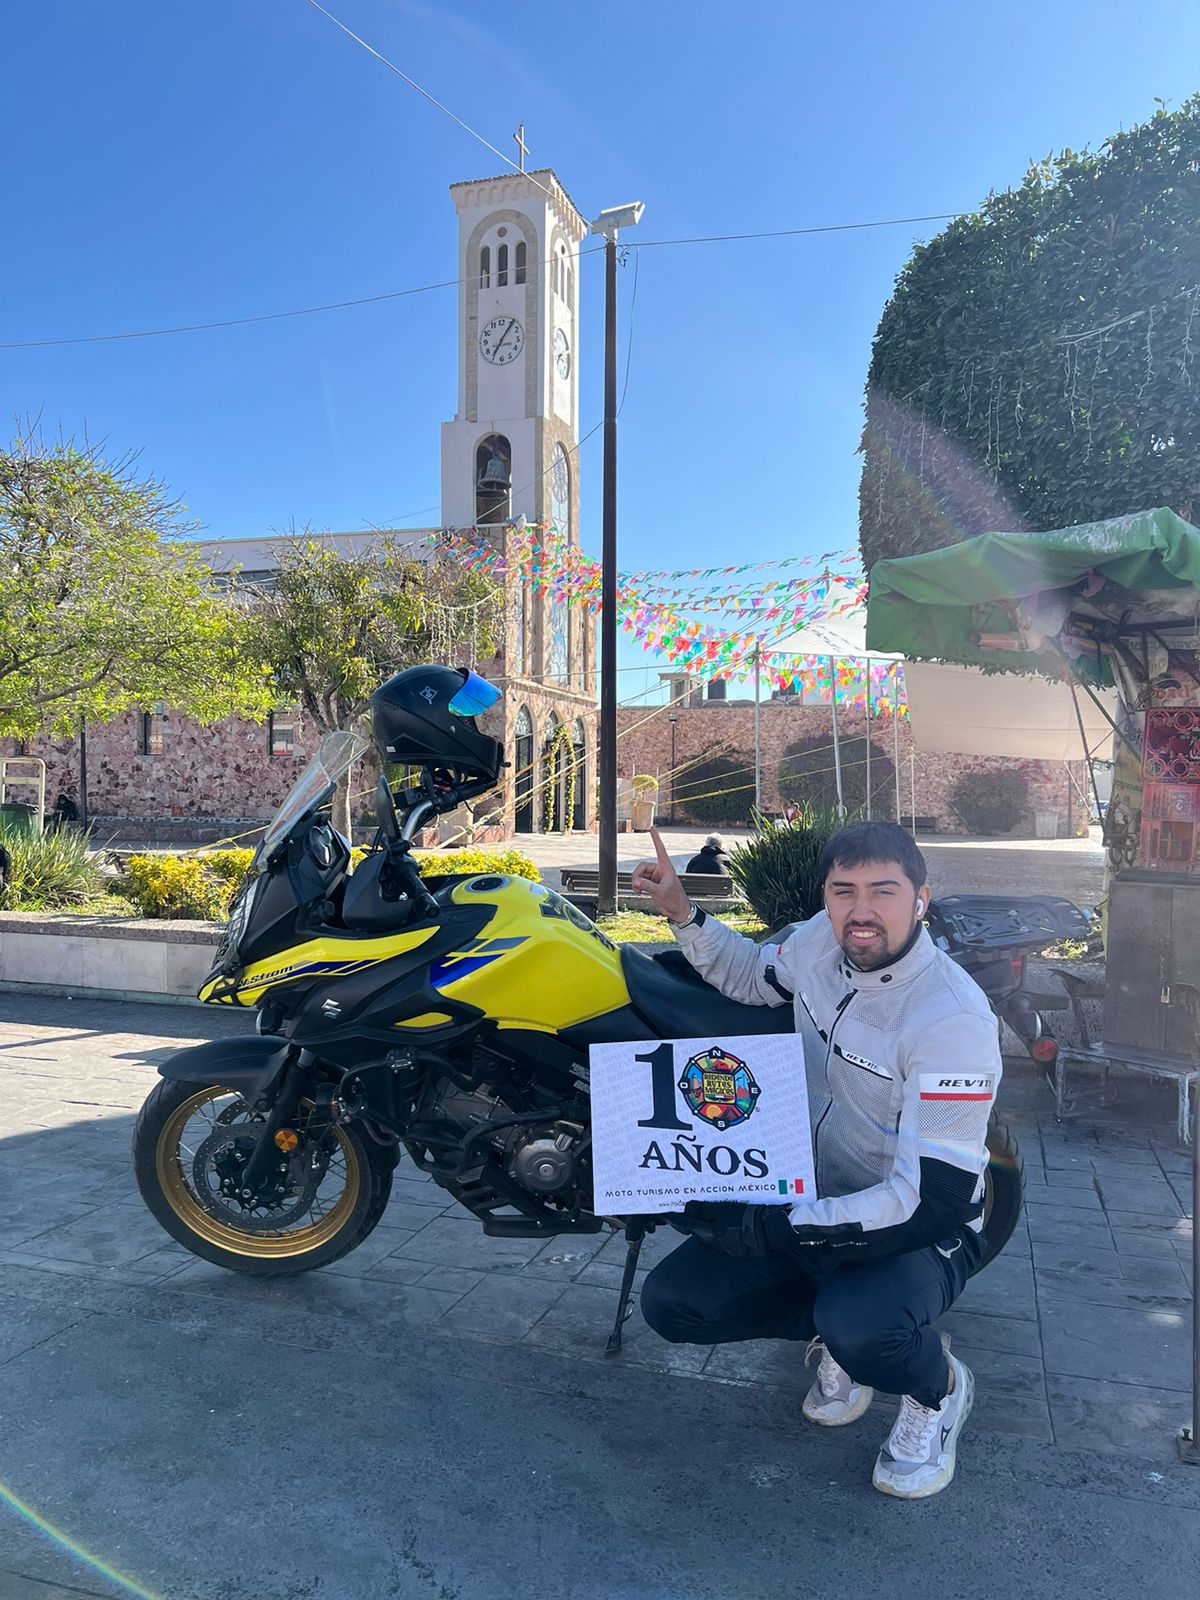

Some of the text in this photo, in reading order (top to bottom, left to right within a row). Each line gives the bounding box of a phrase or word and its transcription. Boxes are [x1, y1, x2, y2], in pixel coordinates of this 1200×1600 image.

[938, 1079, 992, 1088] REV'IT!
[638, 1133, 769, 1179] AÑOS
[605, 1189, 633, 1197] MOTO
[637, 1187, 680, 1196] TURISMO
